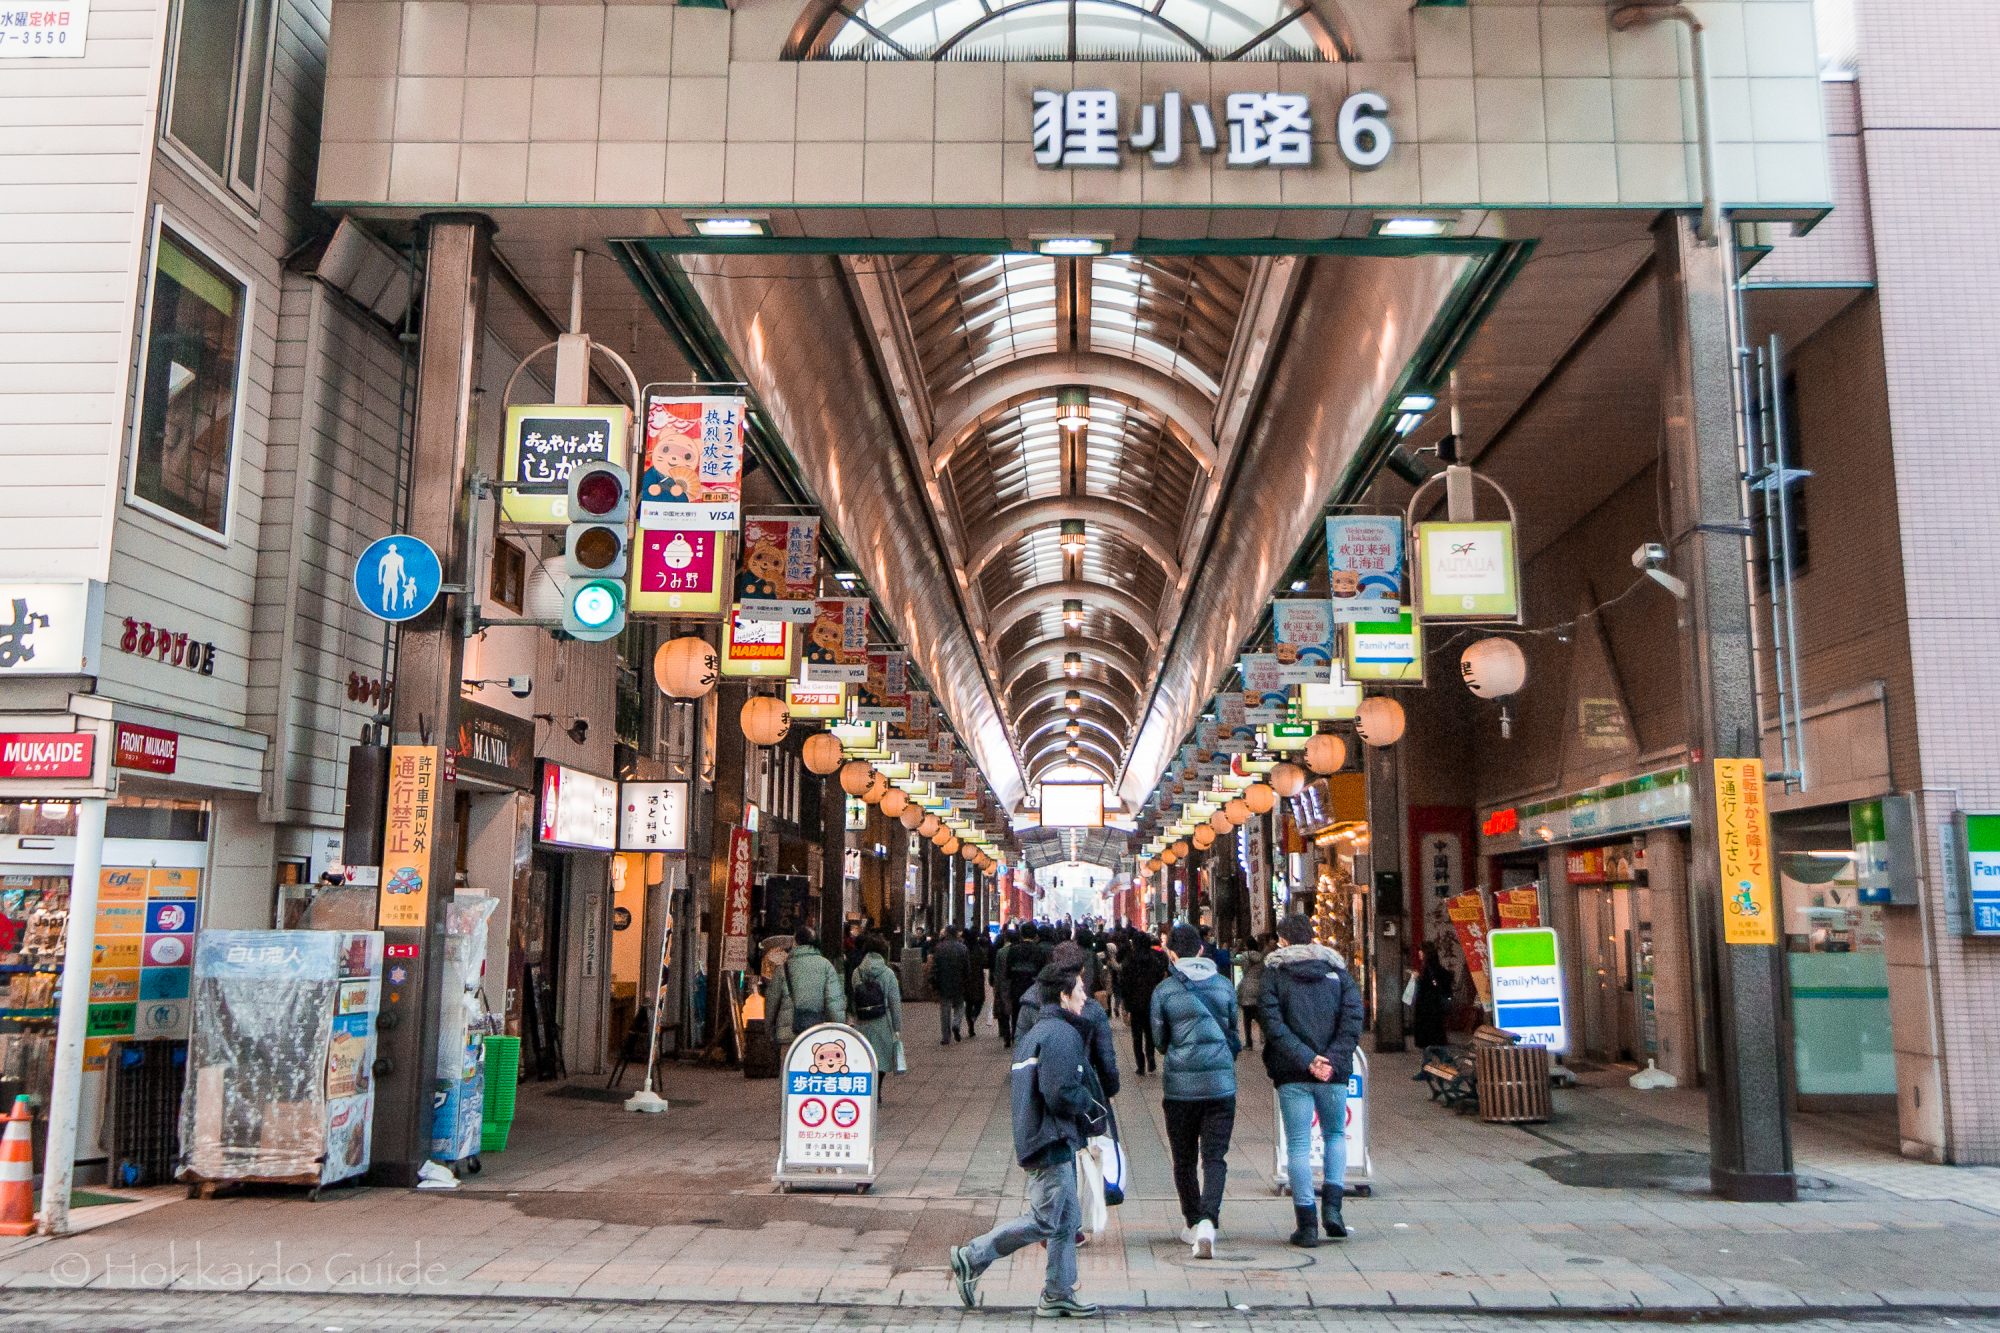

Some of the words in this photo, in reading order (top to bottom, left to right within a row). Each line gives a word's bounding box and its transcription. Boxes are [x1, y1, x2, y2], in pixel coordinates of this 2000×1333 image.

[1, 12, 70, 26] 水曜定休日
[1032, 88, 1313, 168] 狸小路
[1336, 91, 1393, 169] 6
[525, 431, 604, 454] おみやげの店
[721, 409, 737, 476] ようこそ
[709, 511, 735, 520] VISA
[802, 527, 814, 579] ようこそ
[1346, 556, 1385, 569] 北海道
[656, 571, 699, 589] うみ野
[792, 607, 812, 615] VISA
[1382, 606, 1399, 615] VISA
[1461, 595, 1476, 610] 6
[120, 617, 216, 676] おみやげの店
[731, 645, 784, 657] HABANA
[1359, 641, 1410, 650] FamilyMart
[848, 669, 865, 677] VISA
[4, 743, 83, 762] MUKAIDE
[120, 732, 143, 754] FRONT
[145, 736, 175, 759] MUKAIDE
[389, 755, 417, 854] 通行禁止
[413, 756, 432, 854] 許可車両以外
[662, 789, 674, 837] おいしい
[1720, 766, 1741, 877] ご通行ください
[1742, 764, 1762, 876] 自転車から降りて
[387, 946, 413, 956] 6-1
[1496, 976, 1556, 987] FamilyMart
[793, 1076, 868, 1093] 歩行者専用
